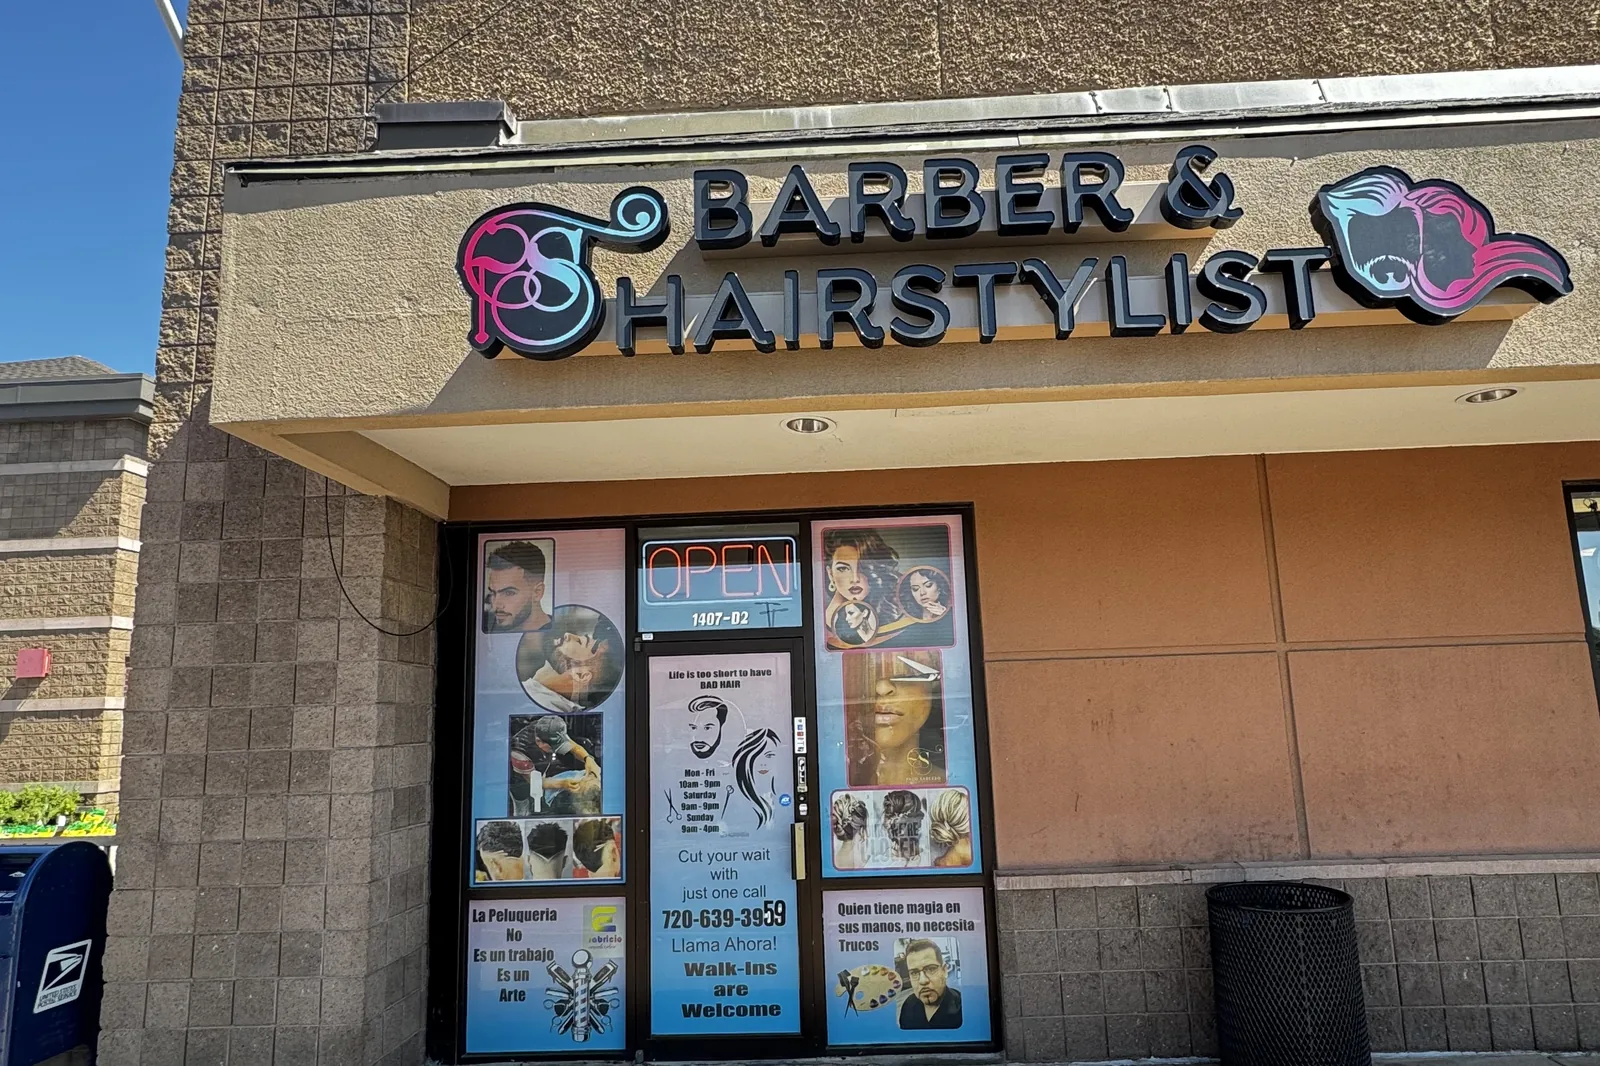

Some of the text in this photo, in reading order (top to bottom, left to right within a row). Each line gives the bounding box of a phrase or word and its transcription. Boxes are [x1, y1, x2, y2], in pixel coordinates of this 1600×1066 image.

[693, 144, 1244, 249] BARBER &
[615, 246, 1332, 356] HAIRSTYLIST
[648, 543, 792, 600] OPEN
[692, 611, 750, 627] 1407-D2
[668, 668, 772, 680] Life is too short to have
[700, 680, 741, 690] BAD HAIR
[684, 768, 701, 778] Mon
[705, 768, 716, 777] Fri
[679, 780, 699, 789] 10am
[705, 780, 721, 789] 9pm
[683, 791, 717, 801] Saturday
[681, 802, 698, 811] 9am
[703, 802, 720, 811] 9pm
[687, 813, 714, 822] Sunday
[681, 825, 698, 834] 9am
[703, 824, 720, 834] 4pm
[678, 848, 771, 866] Cut your wait
[710, 867, 739, 880] with
[682, 885, 767, 903] just one call
[472, 908, 558, 924] La Peluqueria
[662, 900, 787, 929] 720-639-3959
[838, 901, 961, 917] Quien tiene magia en
[838, 918, 975, 934] sus manos, no necesita
[506, 927, 523, 942] No
[672, 936, 777, 953] Llama Ahora!
[838, 939, 880, 952] Trucos
[473, 948, 555, 963] Es un trabajo
[497, 968, 530, 982] Es un
[684, 961, 778, 977] Walk-Ins
[499, 987, 527, 1002] Arte
[714, 984, 749, 997] are
[682, 1003, 782, 1018] Welcome
